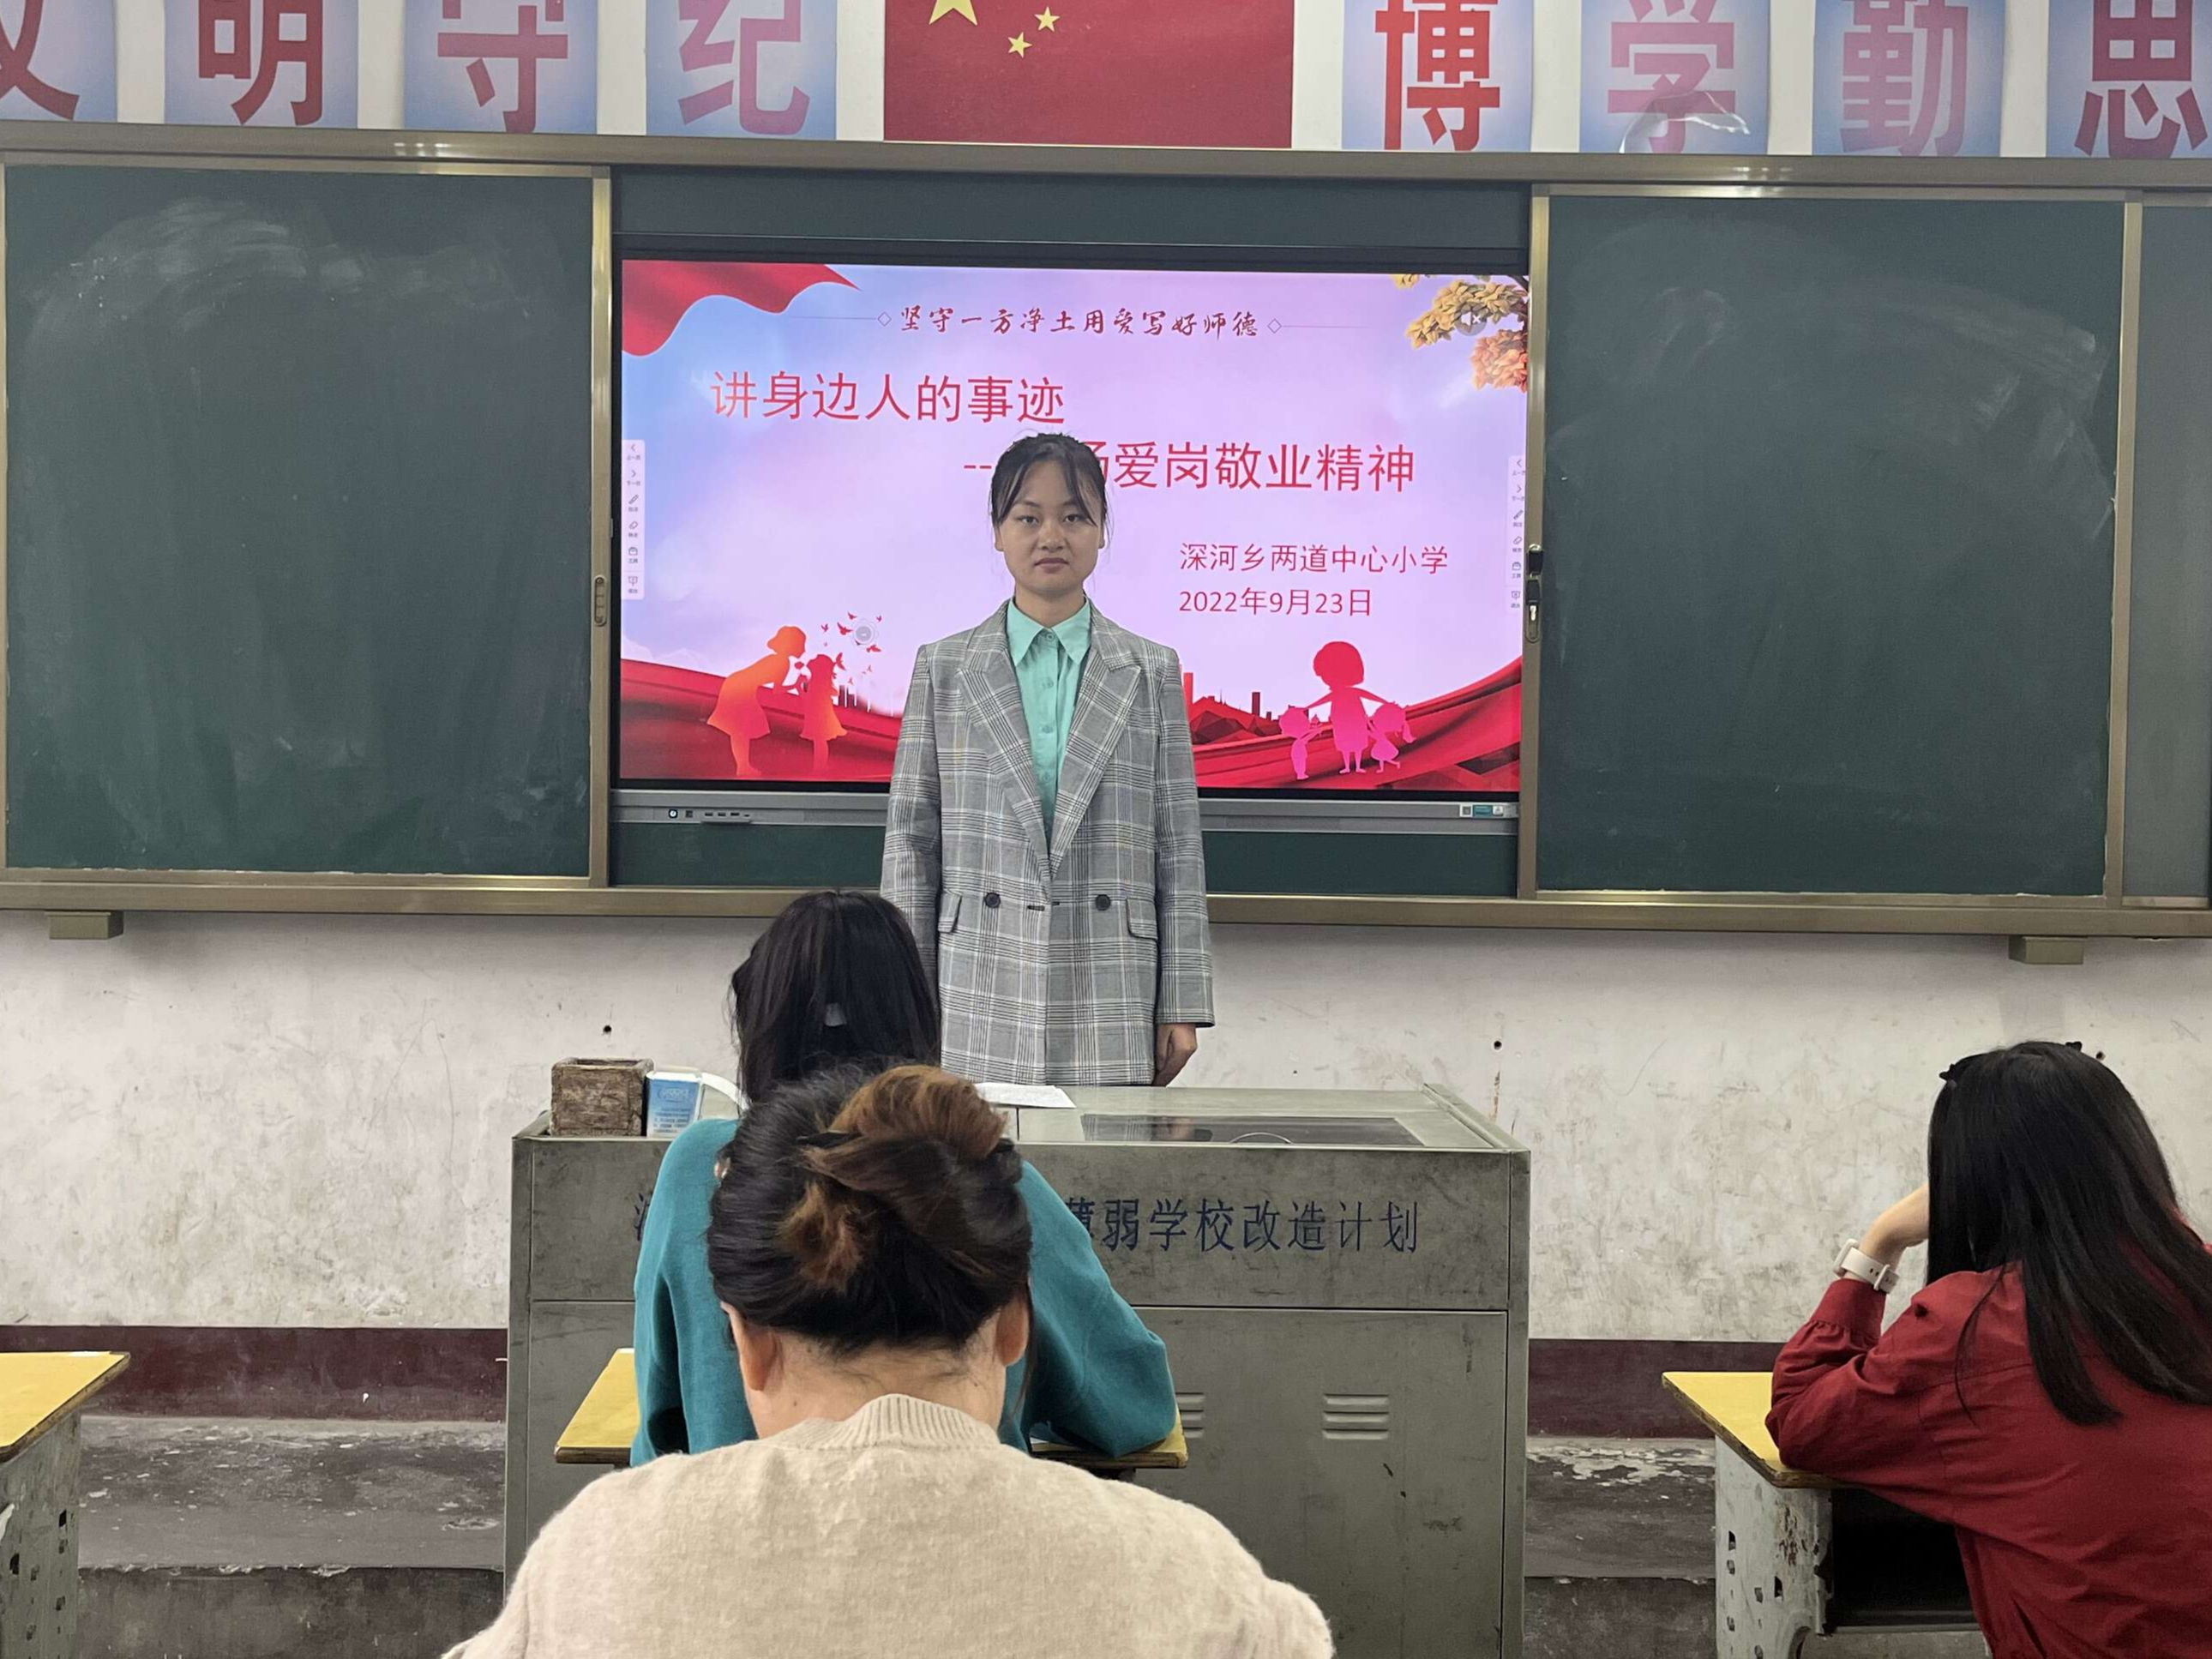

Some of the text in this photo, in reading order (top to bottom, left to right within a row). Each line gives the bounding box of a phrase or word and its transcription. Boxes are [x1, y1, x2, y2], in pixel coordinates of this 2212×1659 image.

[900, 304, 1259, 341] 坚守一方净土用爱写好师德
[710, 370, 1066, 424] 讲身边人的事迹
[1180, 542, 1448, 574] 深河乡两道中心小学
[1179, 586, 1371, 616] 2022年9月23日
